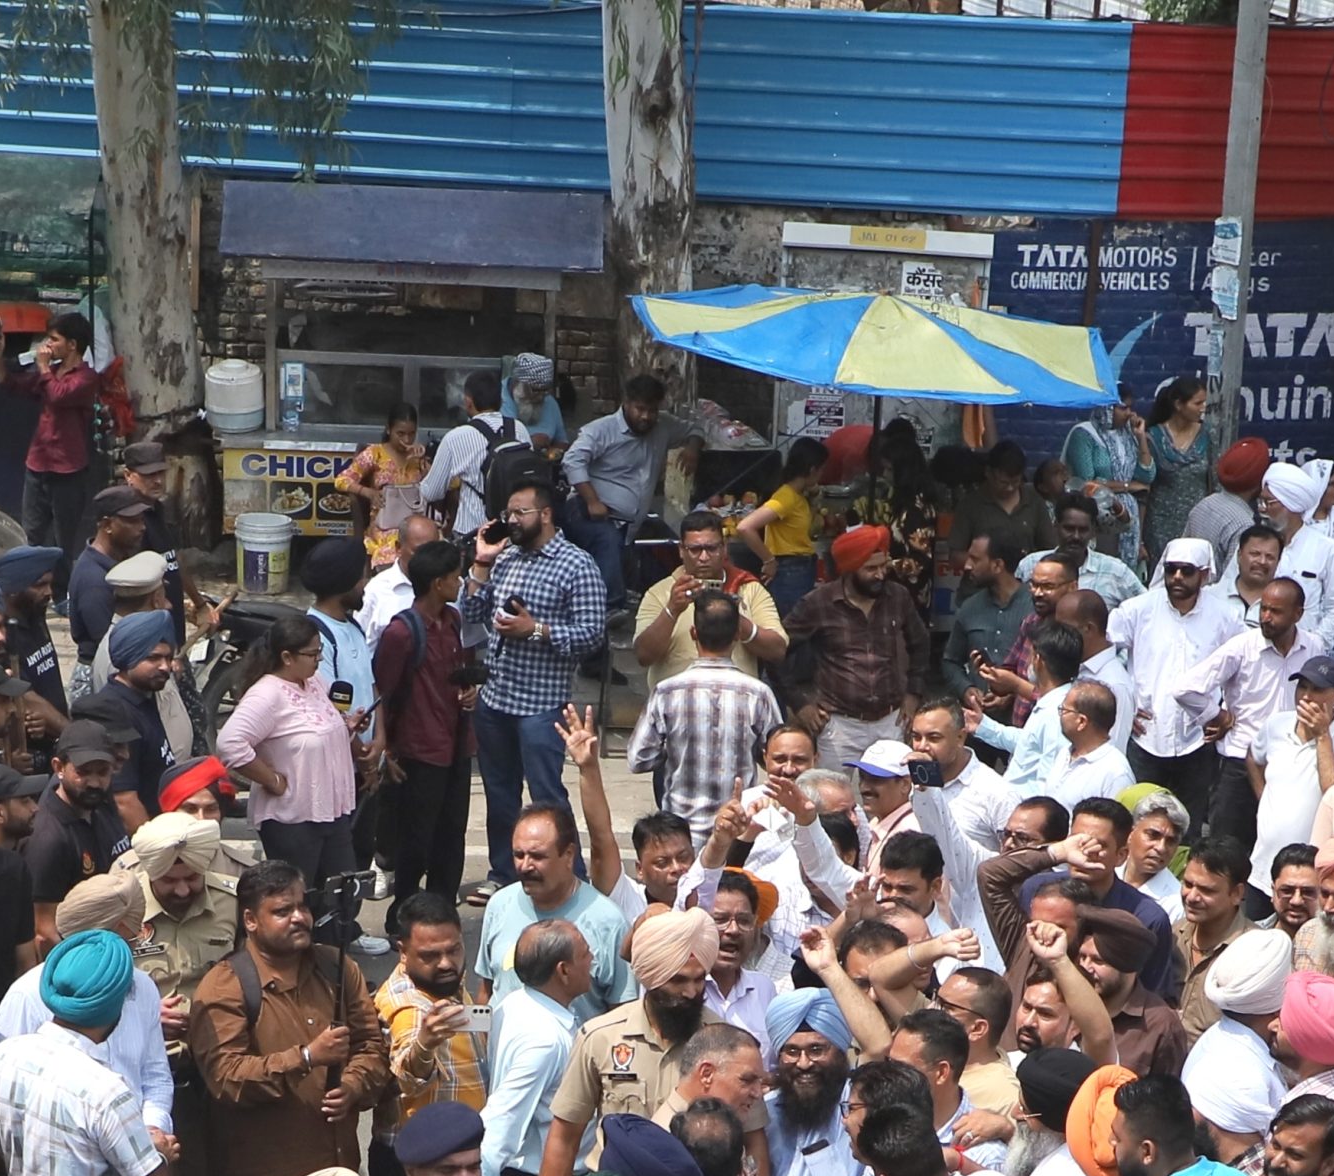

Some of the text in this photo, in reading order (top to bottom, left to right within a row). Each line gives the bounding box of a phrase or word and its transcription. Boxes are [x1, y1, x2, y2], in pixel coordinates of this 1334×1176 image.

[1017, 244, 1178, 268] TATA MOTORS
[906, 268, 945, 289] कैंसर
[1011, 272, 1170, 291] COMMERCIA VEHICLES
[241, 453, 359, 479] CHICK
